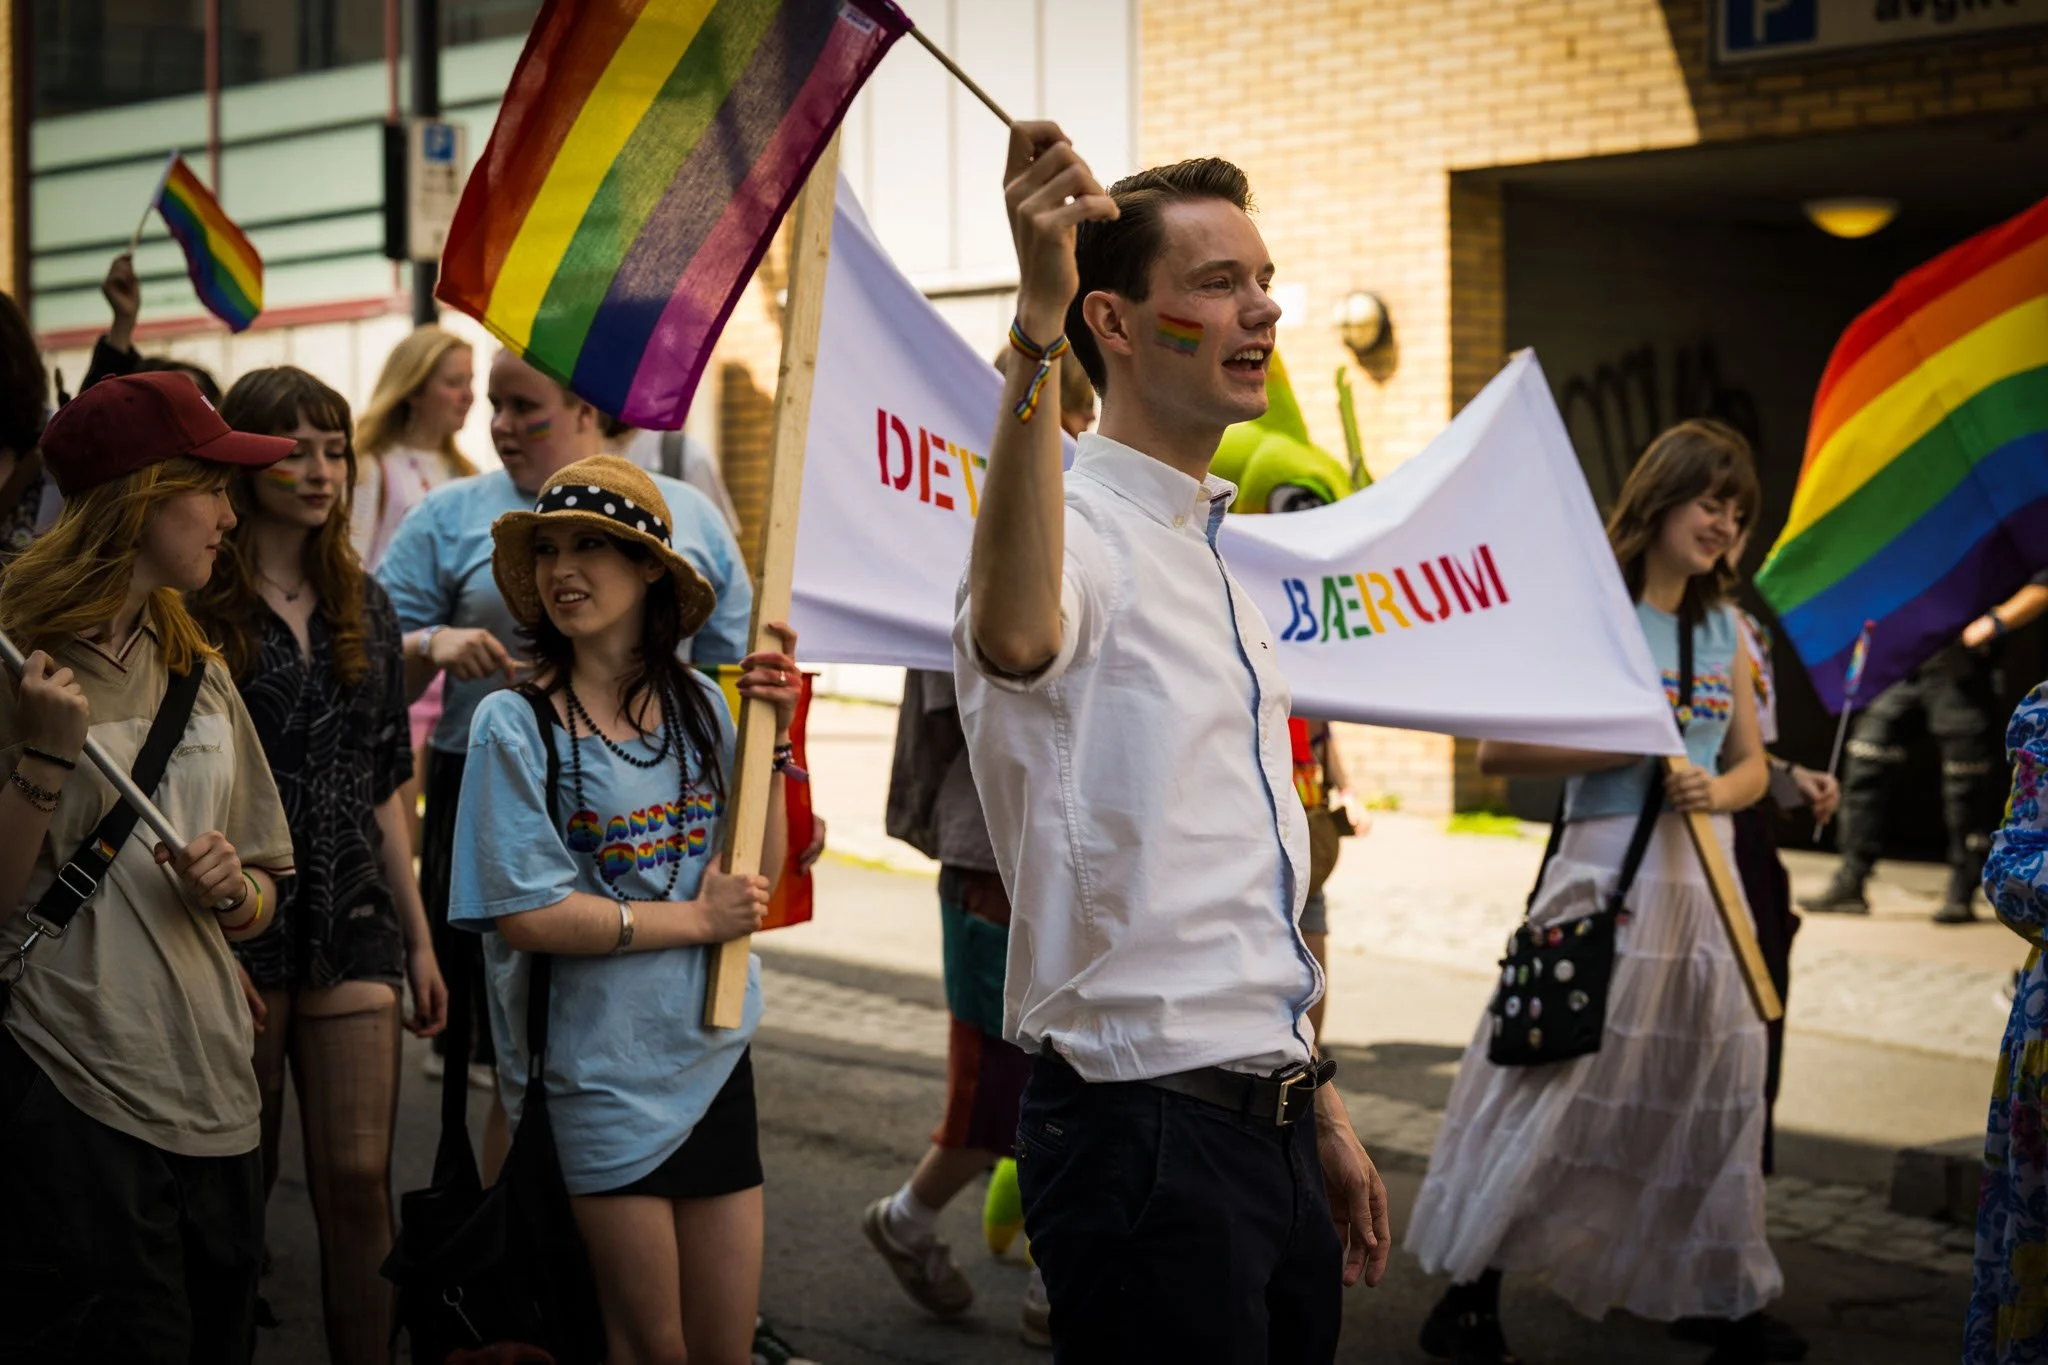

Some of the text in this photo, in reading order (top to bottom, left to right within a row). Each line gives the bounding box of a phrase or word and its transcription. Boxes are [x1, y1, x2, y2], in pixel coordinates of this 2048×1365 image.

[1874, 0, 2020, 25] avg
[877, 407, 987, 520] DET
[1280, 543, 1510, 642] BÆRUM
